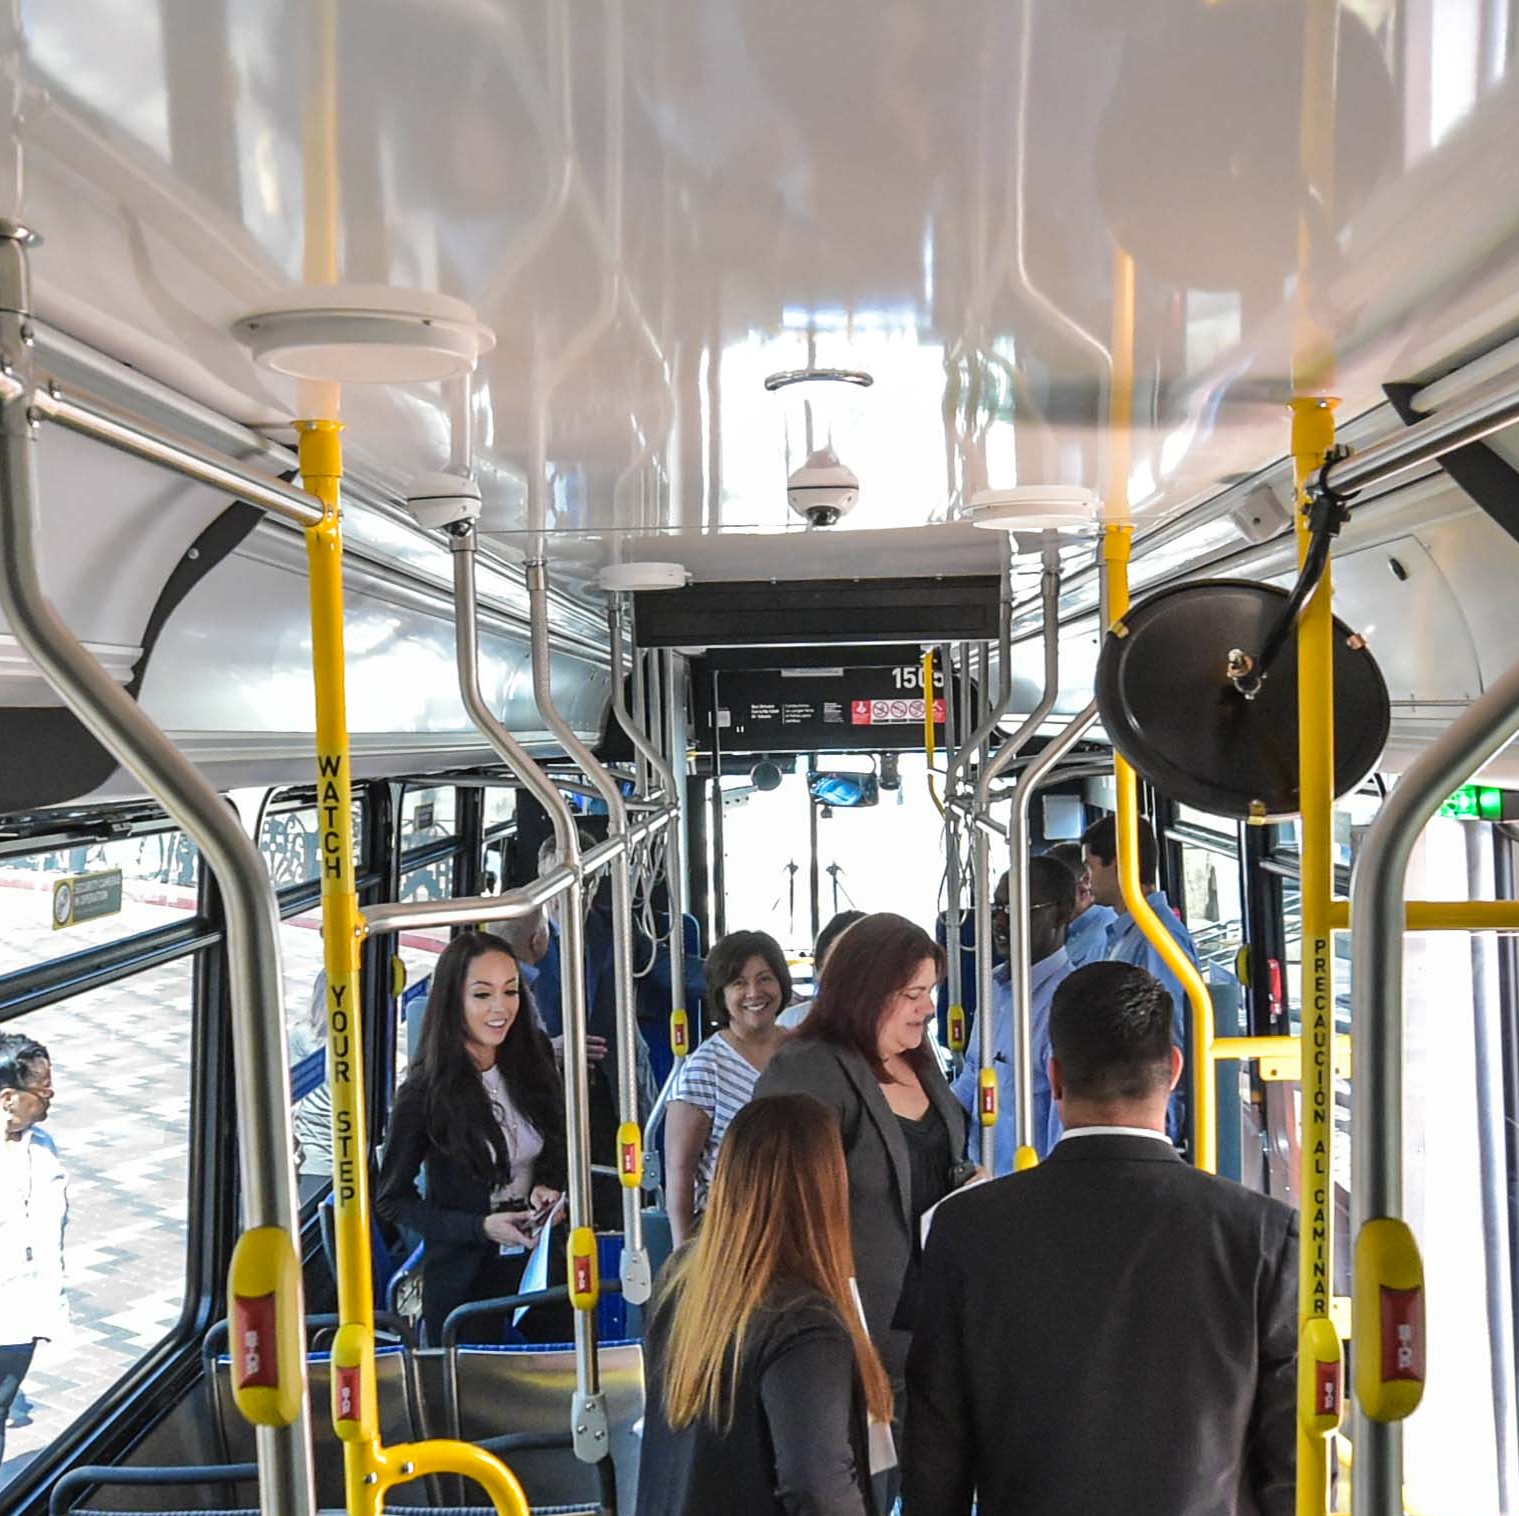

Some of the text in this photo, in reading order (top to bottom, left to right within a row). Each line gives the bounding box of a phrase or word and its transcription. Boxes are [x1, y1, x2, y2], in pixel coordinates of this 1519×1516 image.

[318, 755, 355, 1207] WATCH YOUR STEP
[1313, 1140, 1325, 1174] AL
[1312, 1189, 1326, 1314] CAMINAR
